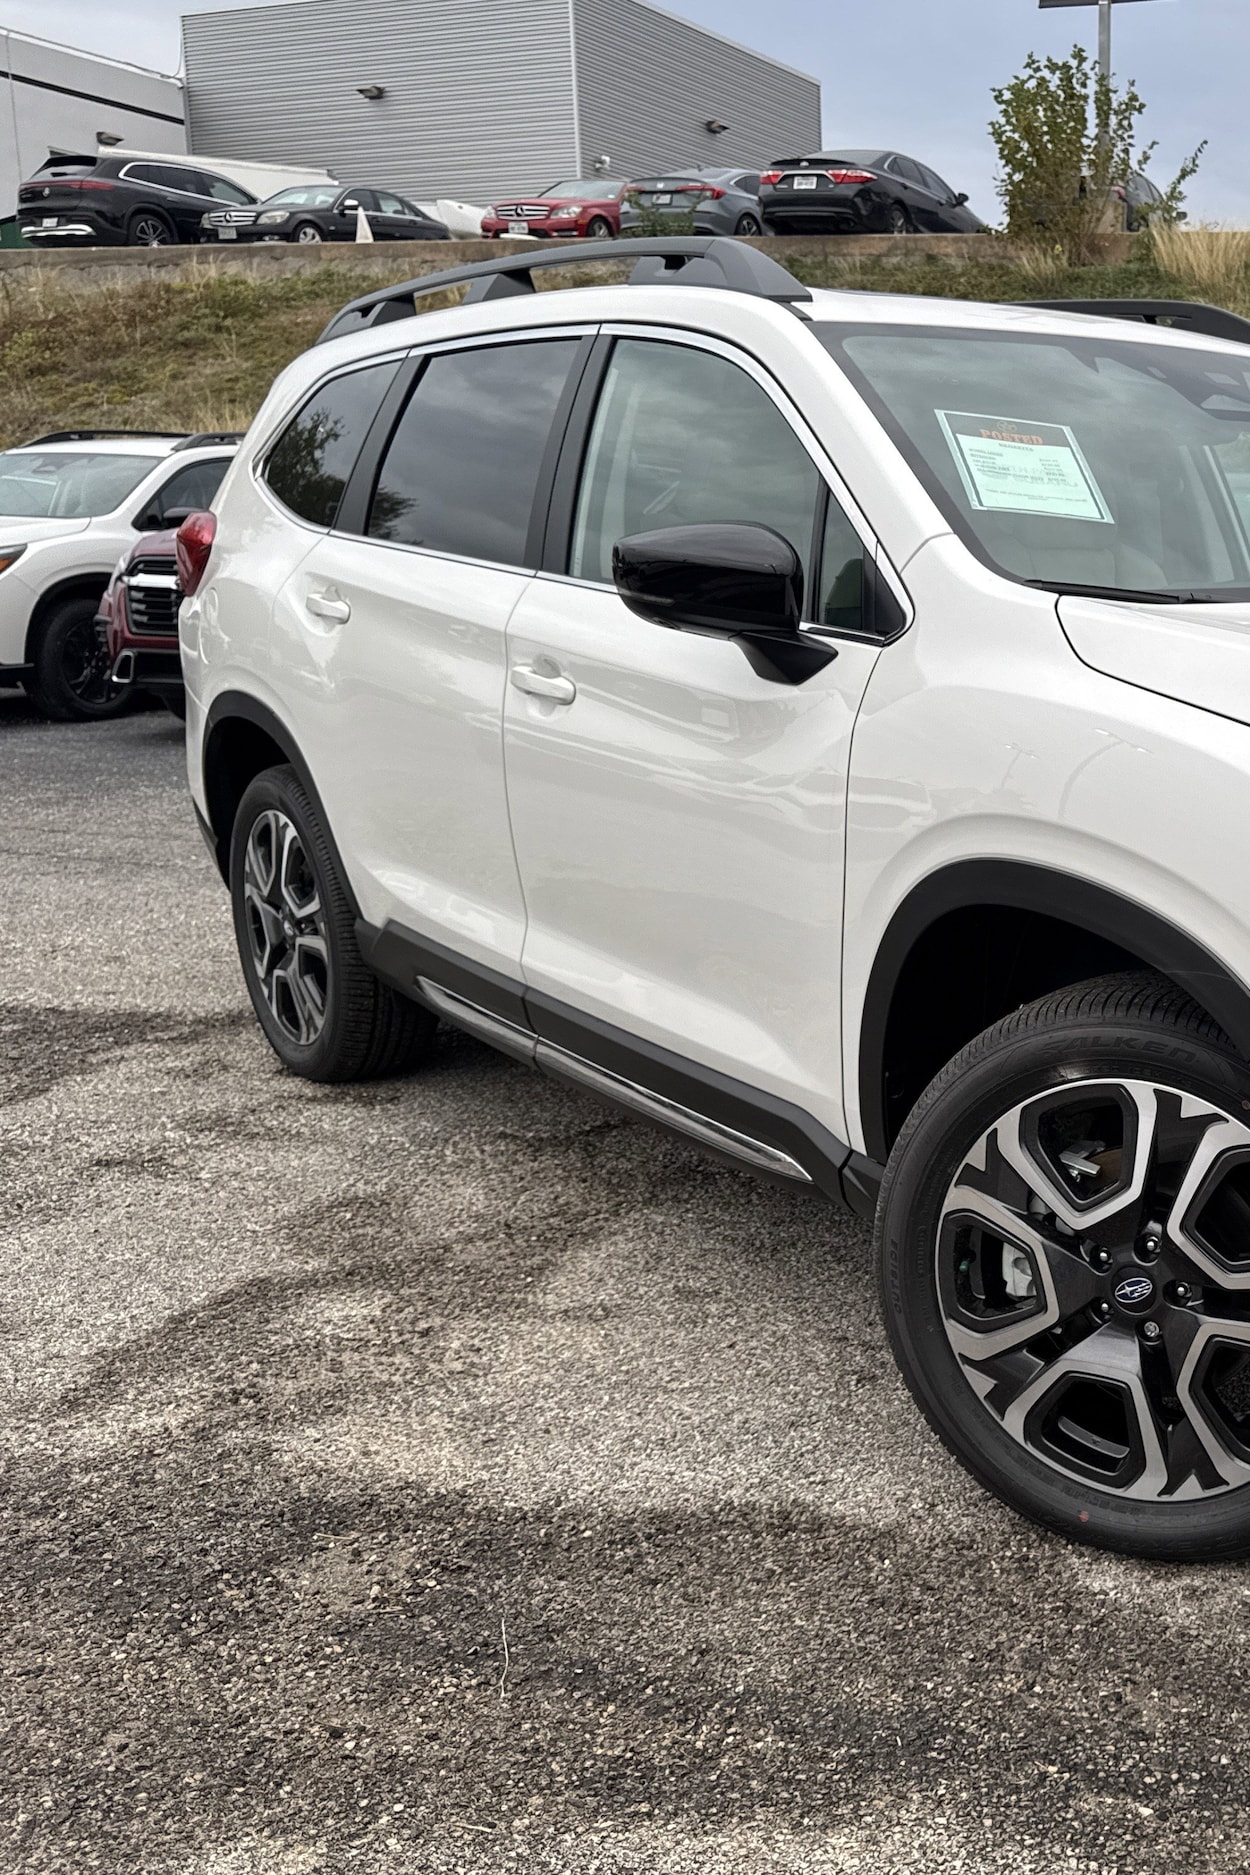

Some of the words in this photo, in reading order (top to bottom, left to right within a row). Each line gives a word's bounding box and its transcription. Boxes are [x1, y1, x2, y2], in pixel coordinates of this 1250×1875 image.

[979, 428, 1043, 445] POSTED
[1038, 1035, 1198, 1064] FALKEN
[890, 1238, 903, 1314] OUTSIDE
